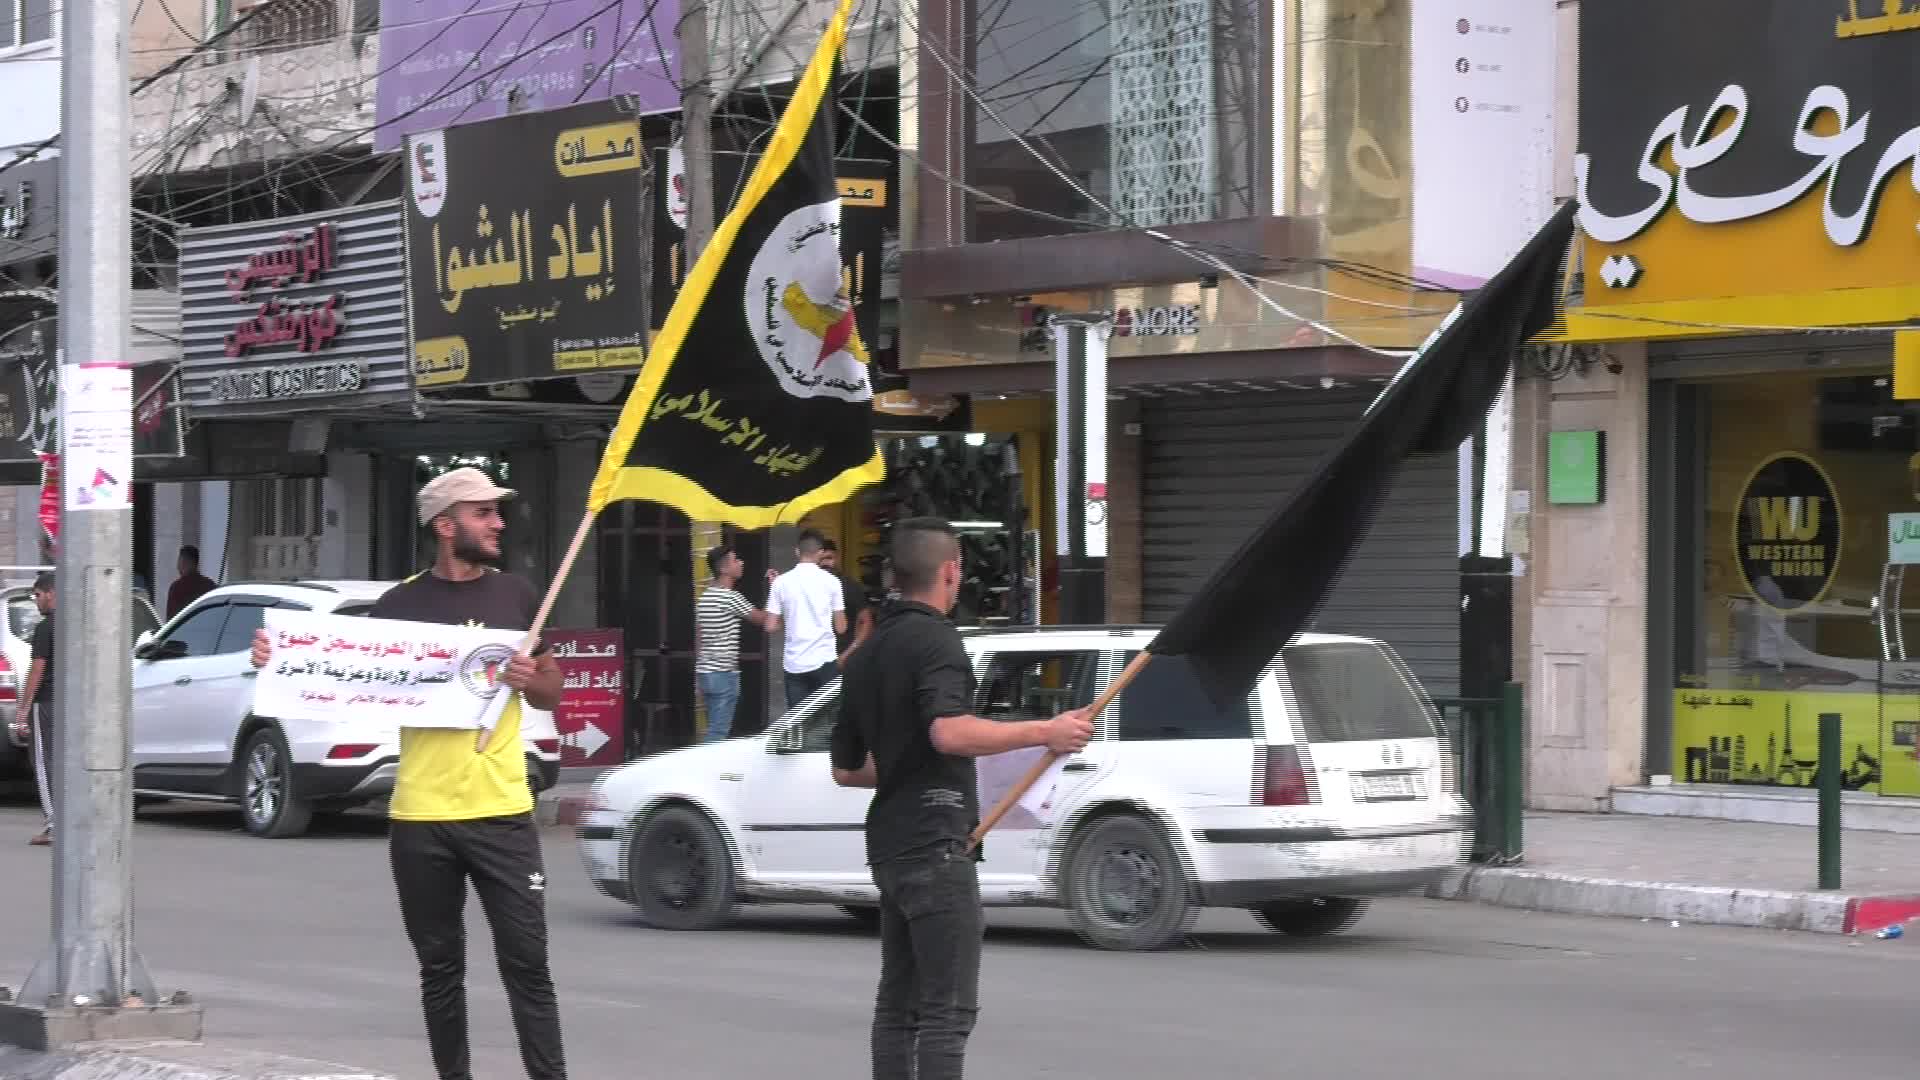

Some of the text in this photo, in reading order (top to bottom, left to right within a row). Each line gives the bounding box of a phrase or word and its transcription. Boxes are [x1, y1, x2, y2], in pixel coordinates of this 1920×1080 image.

[560, 136, 634, 167] محلات
[432, 203, 534, 314] الشوا
[548, 198, 615, 301] إياد
[209, 361, 360, 400] RANTISI COSMETICS
[1748, 496, 1821, 542] WU
[1747, 545, 1825, 561] WESTERN
[1771, 561, 1824, 577] UNION
[551, 639, 616, 659] محلات
[562, 668, 589, 691] الش
